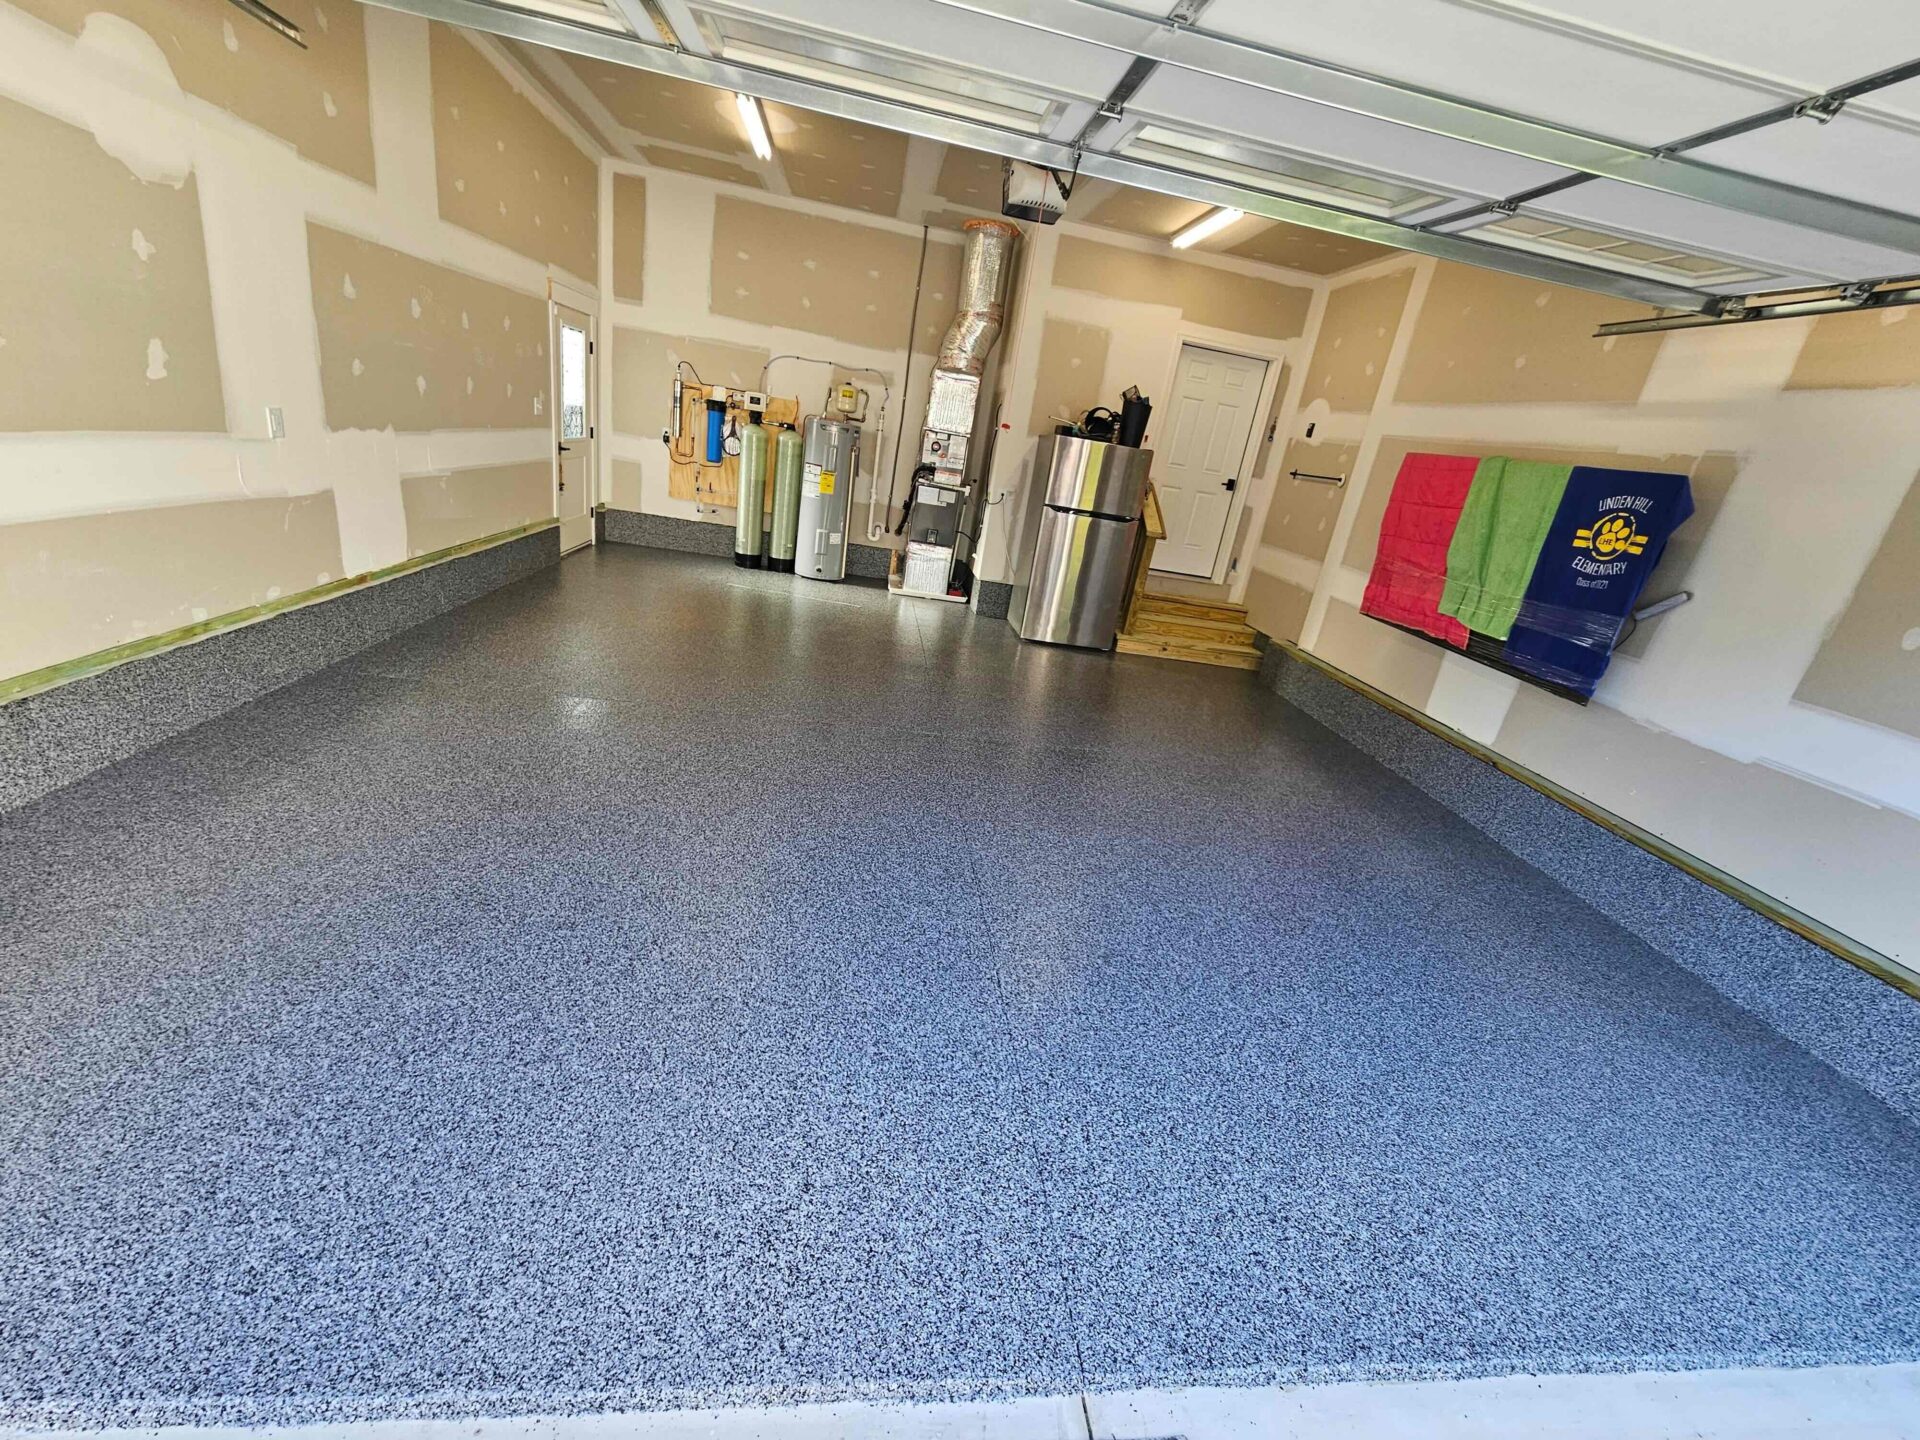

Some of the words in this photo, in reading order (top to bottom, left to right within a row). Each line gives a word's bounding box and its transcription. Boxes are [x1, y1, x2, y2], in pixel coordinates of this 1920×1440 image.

[1599, 496, 1635, 511] LINDEN
[1632, 496, 1653, 514] HILL
[1599, 538, 1613, 546] LHE
[1571, 556, 1627, 576] ELEMENTARY
